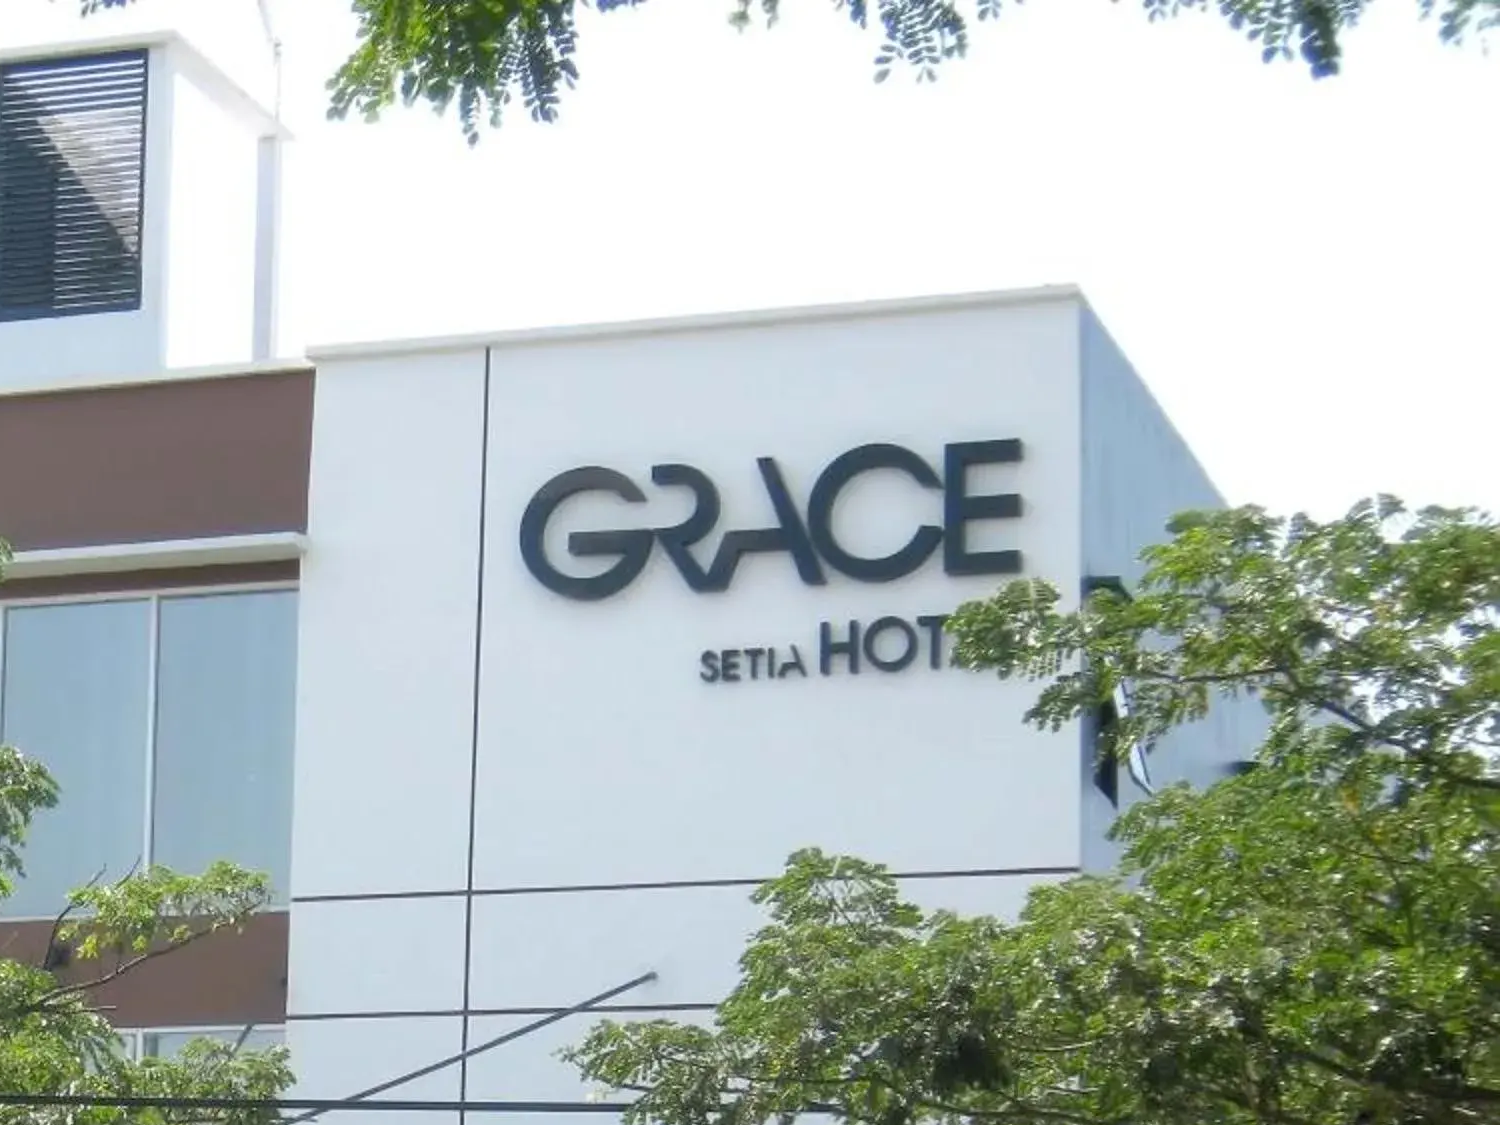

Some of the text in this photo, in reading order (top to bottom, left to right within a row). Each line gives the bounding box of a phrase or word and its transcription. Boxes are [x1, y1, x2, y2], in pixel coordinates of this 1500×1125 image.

[518, 437, 1023, 601] GRACE
[699, 612, 952, 683] SETIA HOT
